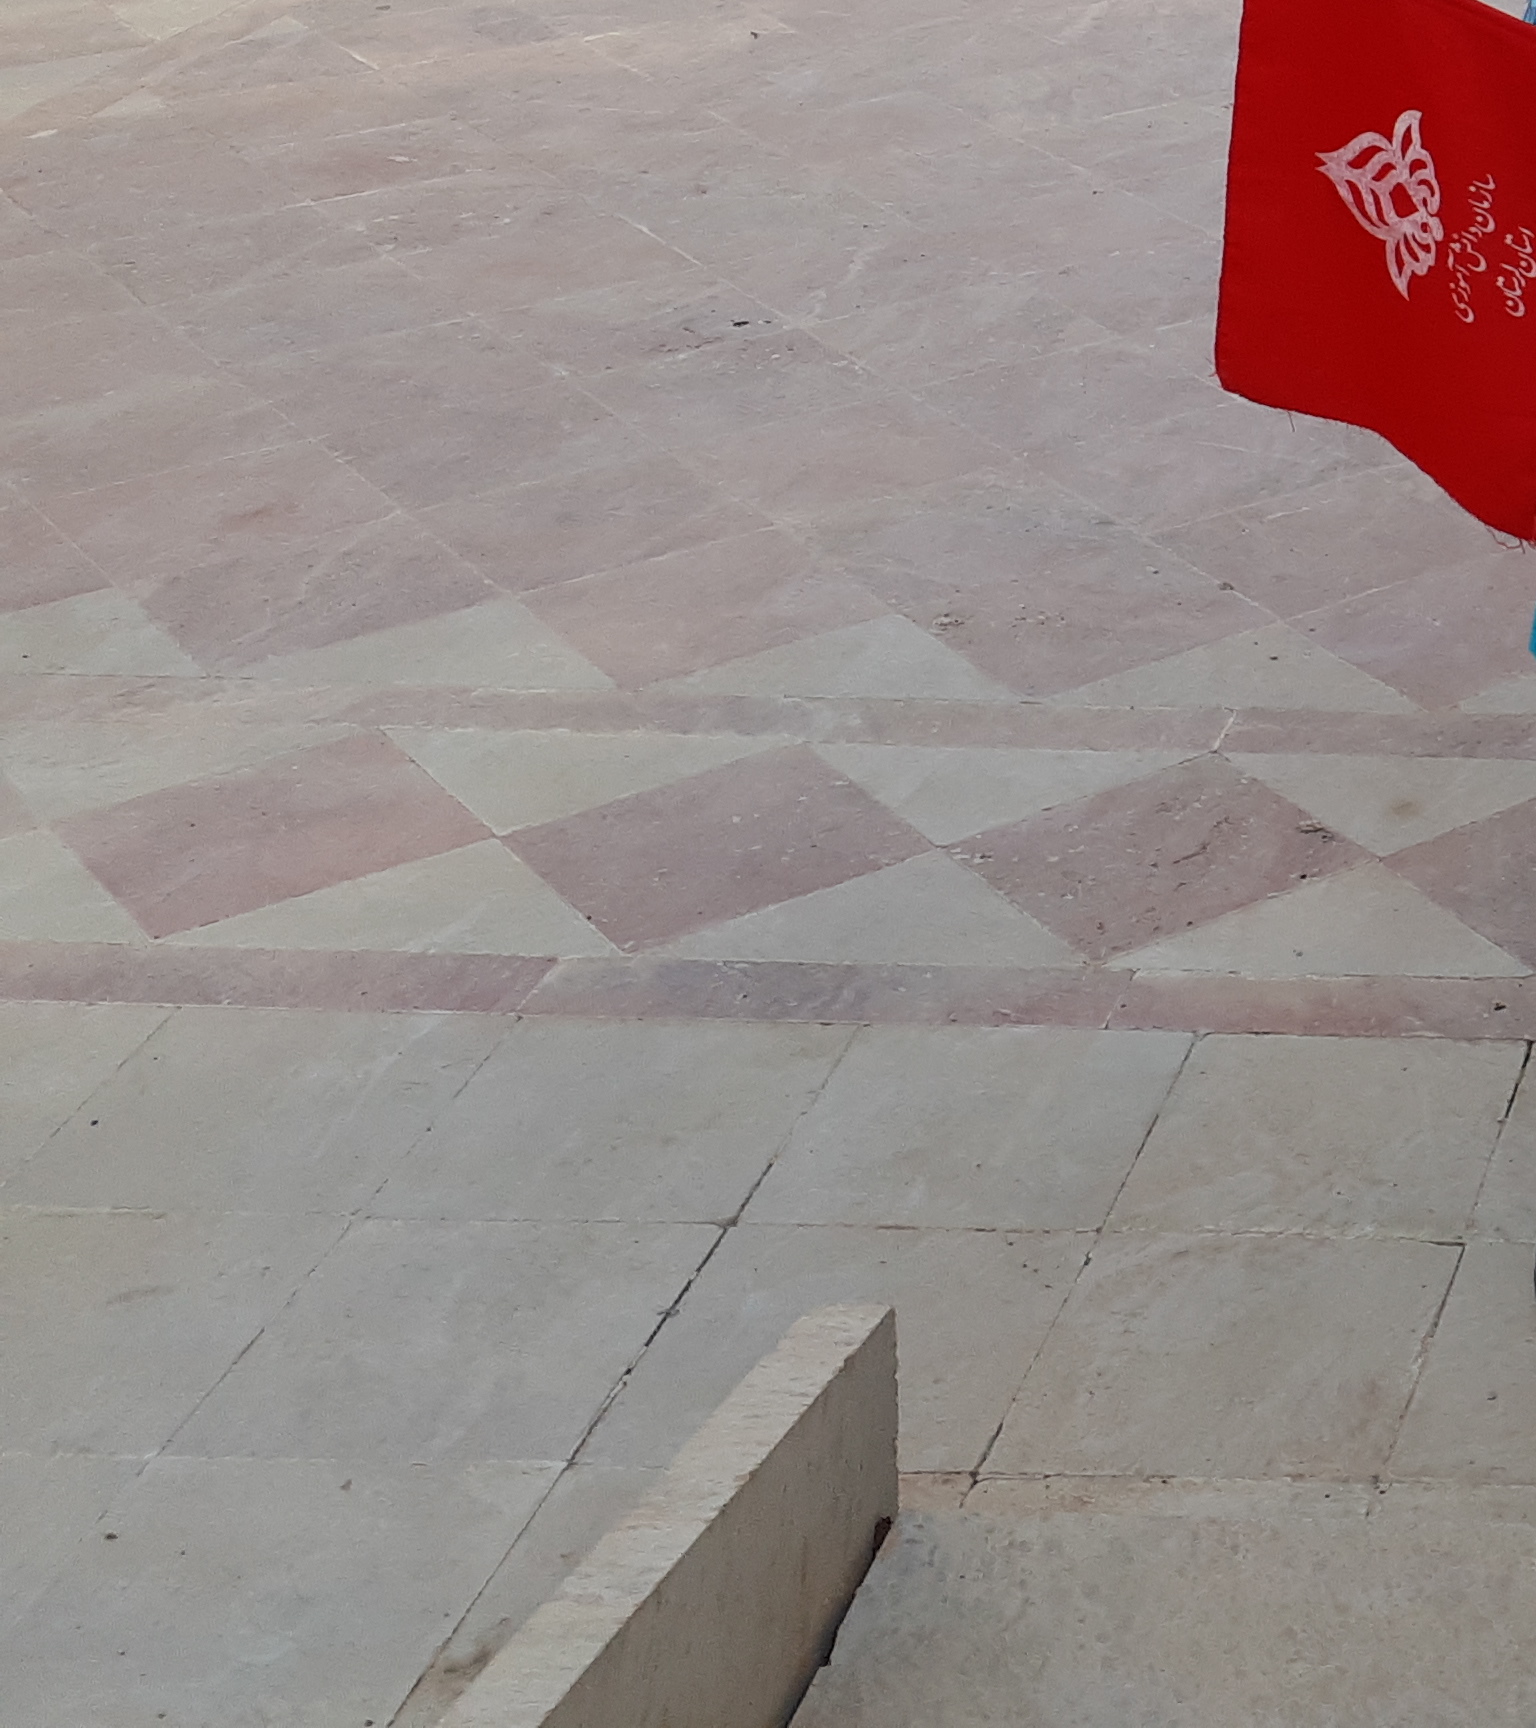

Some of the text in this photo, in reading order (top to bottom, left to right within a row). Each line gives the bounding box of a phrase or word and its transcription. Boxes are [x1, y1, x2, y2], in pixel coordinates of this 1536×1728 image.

[1446, 172, 1497, 324] سازمان دانش آموزی
[1495, 262, 1527, 318] لرستان
